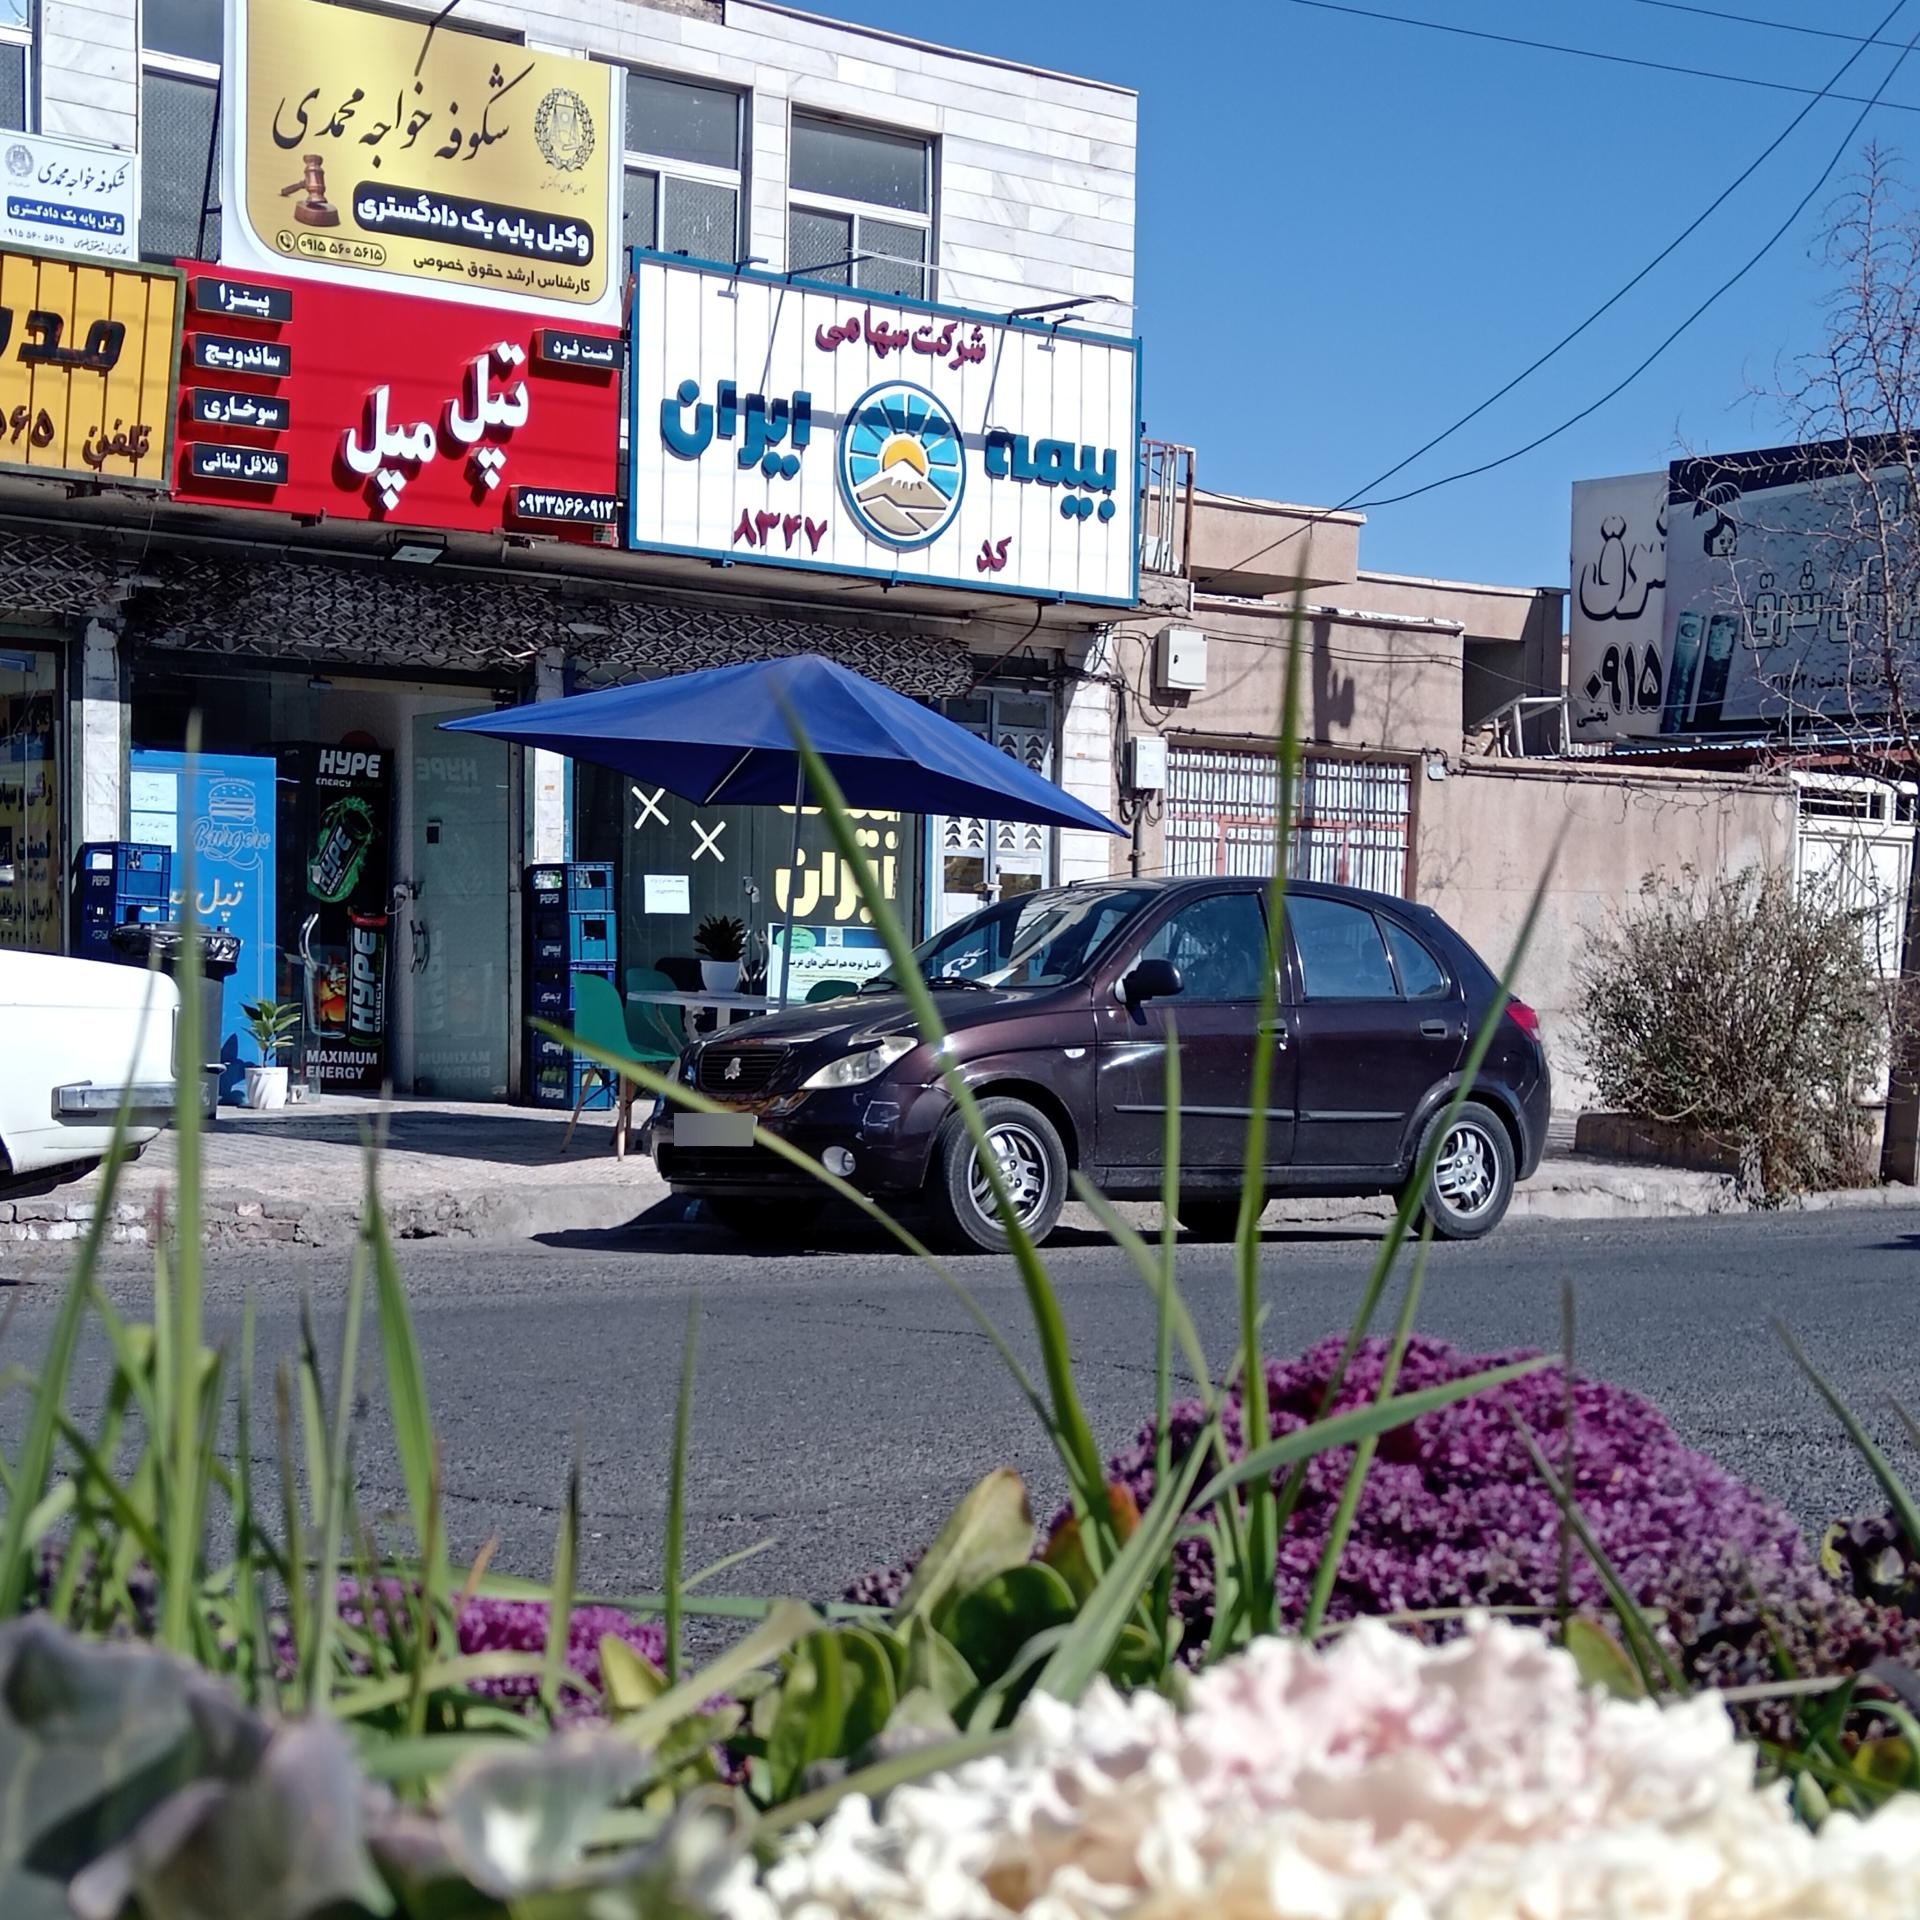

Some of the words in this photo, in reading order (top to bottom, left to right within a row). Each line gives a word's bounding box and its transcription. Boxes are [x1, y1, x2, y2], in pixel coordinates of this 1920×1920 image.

[272, 87, 365, 150] محمدی
[358, 80, 433, 169] خواجه
[434, 62, 536, 161] شکوفه
[38, 162, 69, 184] محمدی
[65, 167, 95, 196] خواجه
[95, 161, 130, 193] شکوفه
[9, 203, 59, 219] دادگستری
[60, 209, 77, 224] یک
[79, 212, 97, 229] پایه
[98, 215, 122, 232] وکیل
[357, 194, 460, 228] دادگستری
[461, 207, 495, 242] یک
[497, 216, 537, 250] پایه
[537, 218, 590, 257] وکیل
[301, 238, 327, 252] ۰۹۱۵
[329, 242, 351, 255] ۵۶۰
[353, 244, 383, 261] ۵۶۱۵
[413, 256, 465, 273] خصوصی
[467, 260, 503, 280] حقوق
[506, 266, 536, 285] ارشد
[537, 272, 591, 293] کارشناس
[218, 283, 270, 317] پیتزا
[553, 339, 579, 360] فود
[815, 308, 910, 360] سهامی
[910, 320, 986, 371] شرکت
[205, 343, 281, 369] ساندویچ
[581, 344, 614, 362] فست
[203, 395, 279, 426] سوخاری
[448, 340, 529, 491] تپل
[82, 418, 152, 469] تلفن
[660, 378, 812, 482] ایران
[202, 452, 241, 474] لبنانی
[344, 383, 438, 512] مپل
[243, 455, 278, 477] فلافل
[984, 425, 1118, 523] بیمه
[519, 494, 614, 520] ۰۹۳۳۵۶۶۰۹۱۲
[733, 507, 828, 555] ۸۳۴۷
[975, 536, 1013, 573] کد
[1584, 640, 1664, 715] ۰۹۱۵
[319, 749, 381, 778] HYPE
[319, 825, 352, 892] HYPE
[195, 878, 245, 922] تپل
[352, 927, 376, 1033] HYPE
[306, 1050, 377, 1064] MAXIMUM
[306, 1066, 365, 1079] ENERGY
